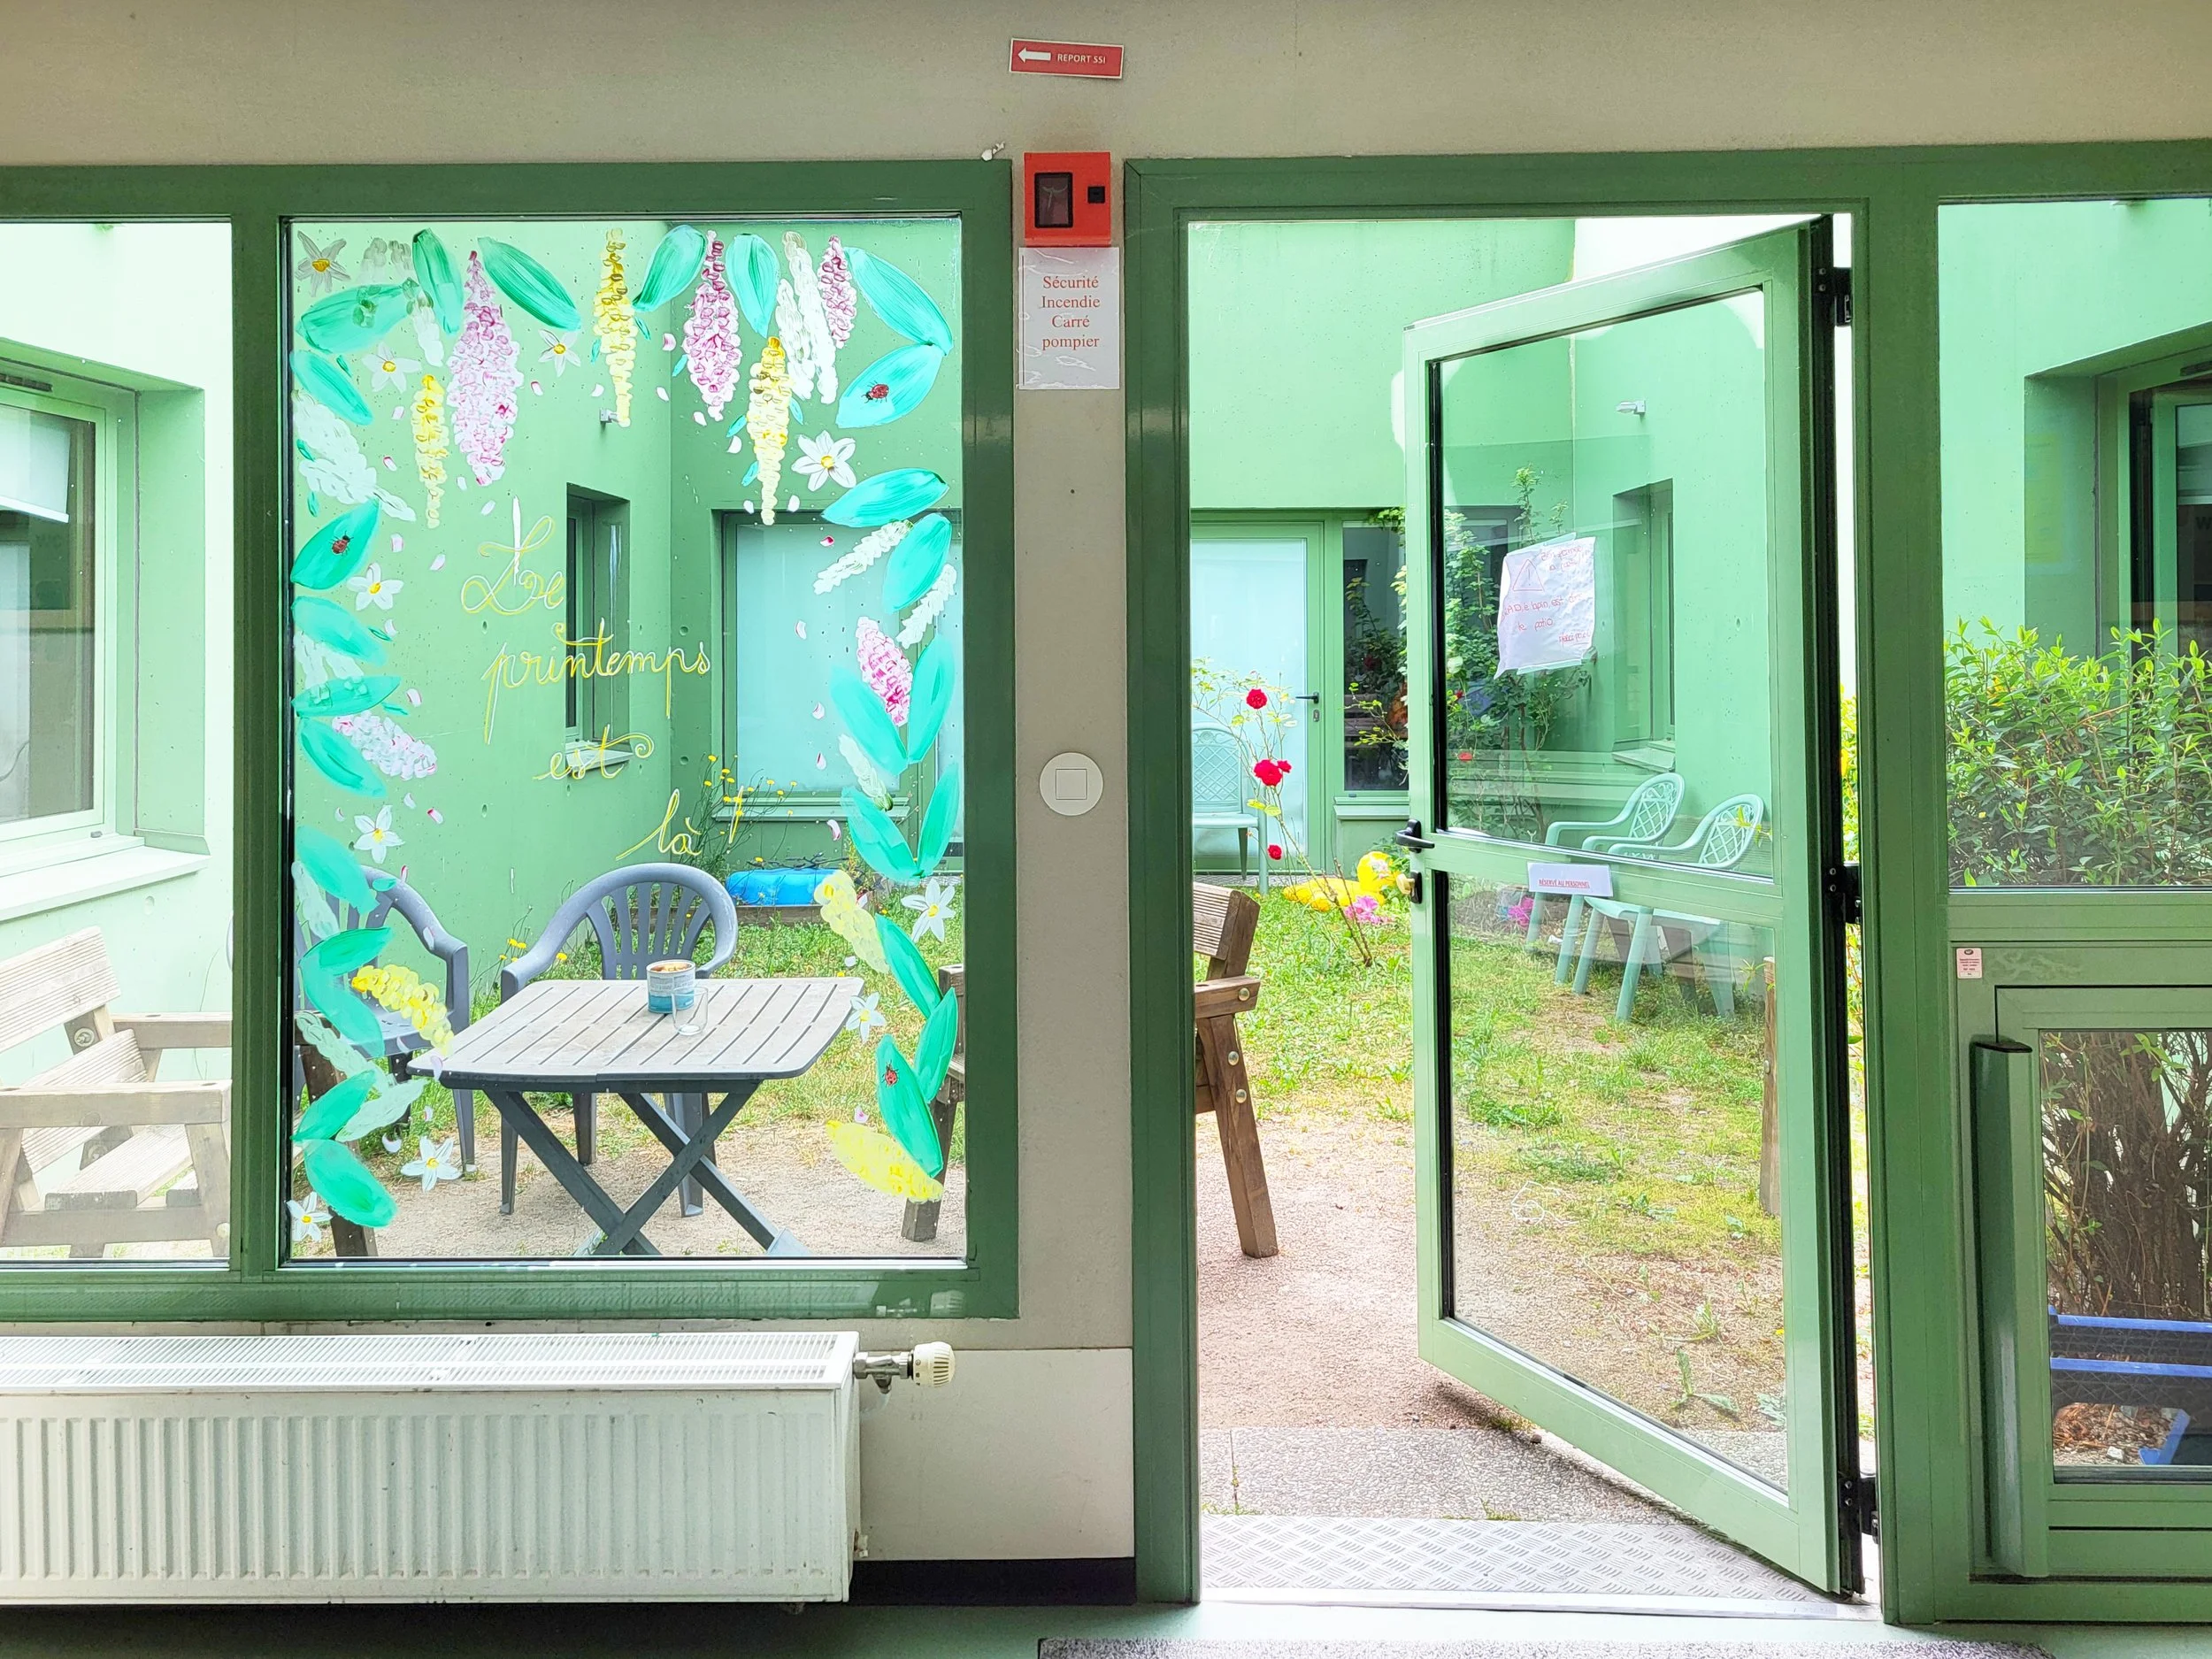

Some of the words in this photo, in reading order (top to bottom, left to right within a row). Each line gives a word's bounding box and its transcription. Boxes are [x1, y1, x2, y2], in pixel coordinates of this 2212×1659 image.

[1056, 53, 1092, 64] REPORT
[1093, 55, 1106, 65] SSI
[1042, 275, 1099, 289] Sécurité
[1041, 295, 1101, 308] Incendie
[1051, 315, 1090, 328] Carré
[1042, 334, 1100, 350] pompier
[460, 514, 566, 617] Le
[481, 617, 712, 745] printemps
[533, 724, 654, 780] est
